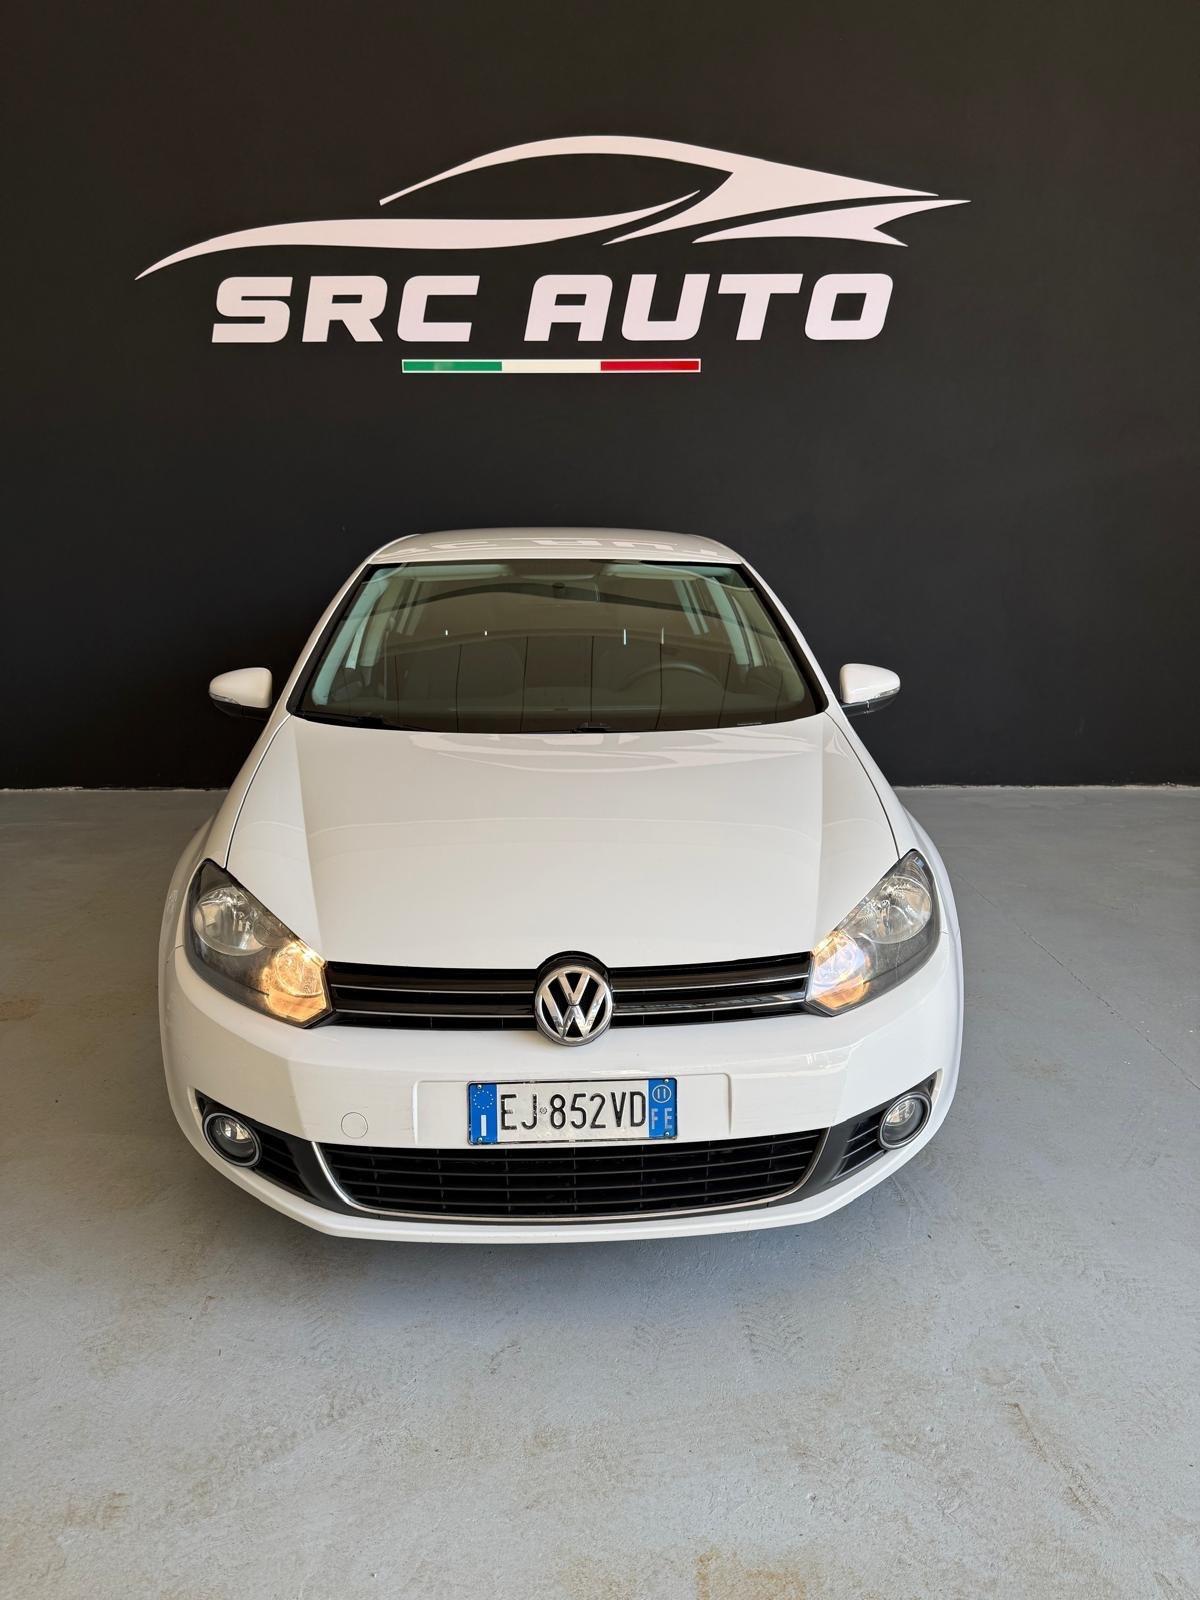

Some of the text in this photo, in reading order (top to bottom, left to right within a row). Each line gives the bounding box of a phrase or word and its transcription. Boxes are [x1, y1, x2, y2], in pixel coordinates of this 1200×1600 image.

[212, 273, 893, 343] SRC AUTO
[539, 968, 607, 1038] VW
